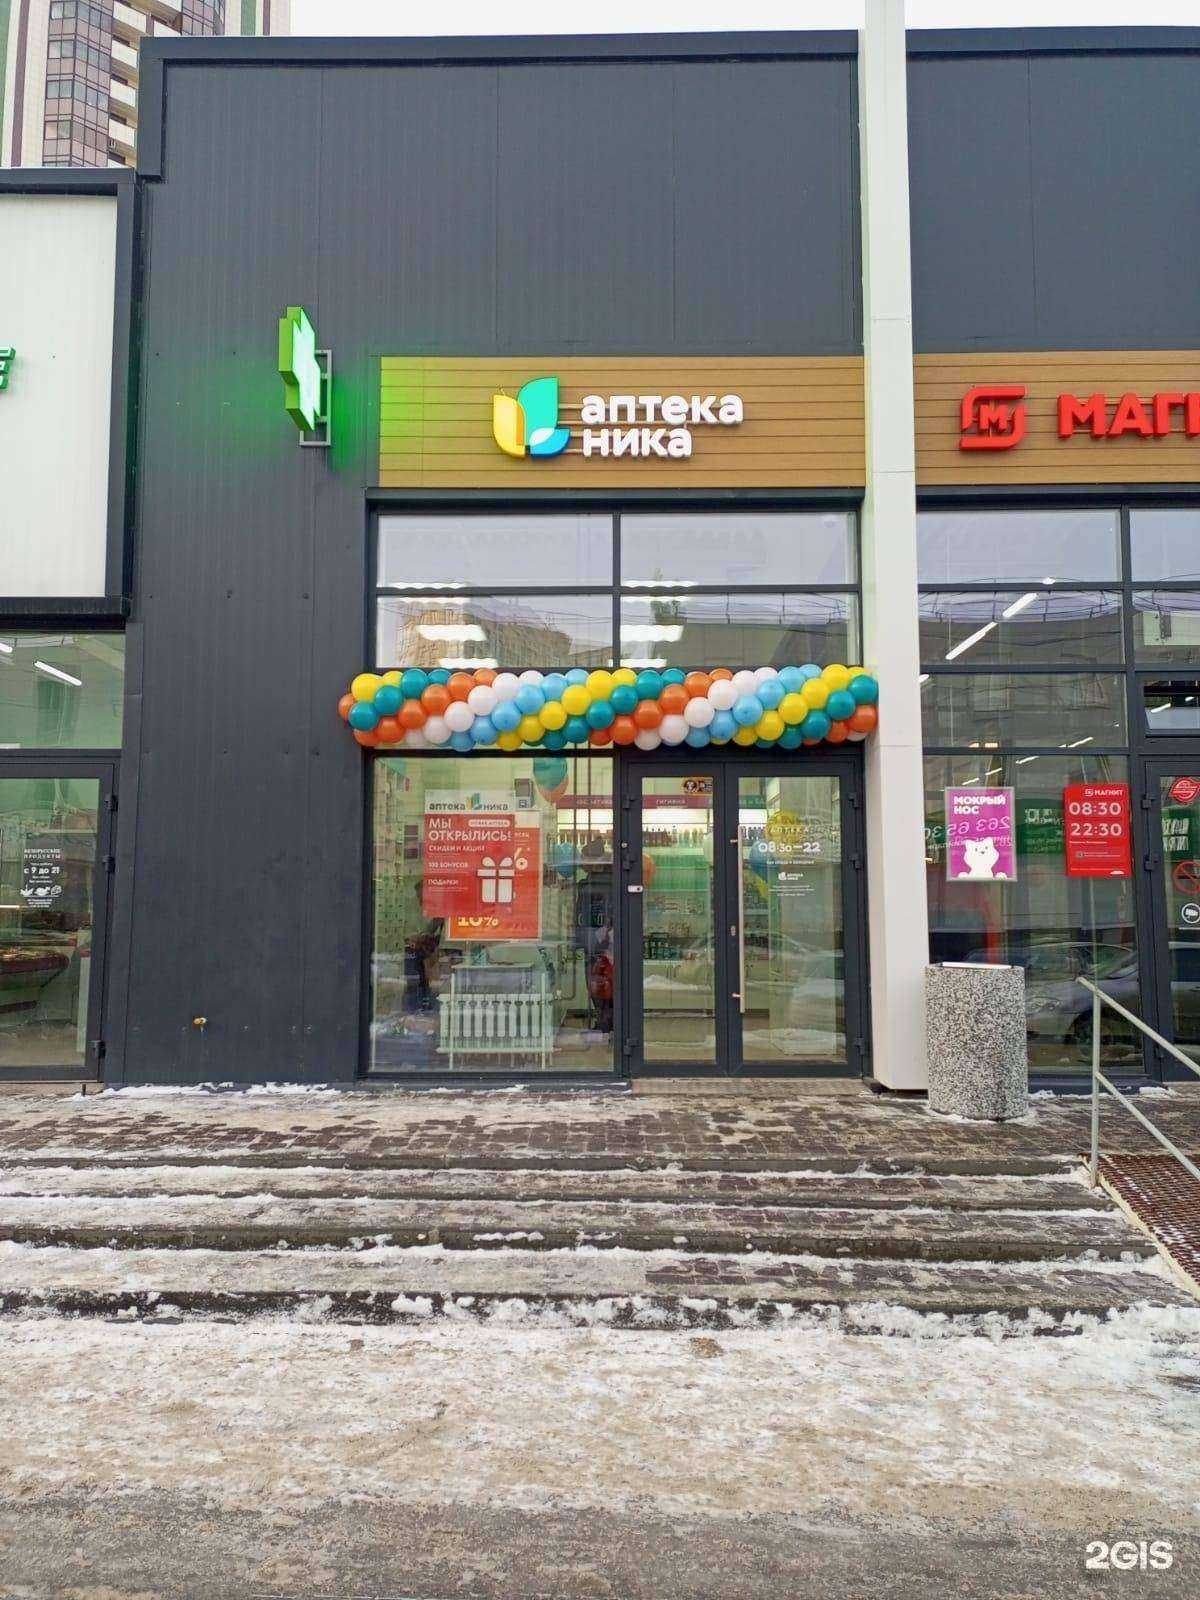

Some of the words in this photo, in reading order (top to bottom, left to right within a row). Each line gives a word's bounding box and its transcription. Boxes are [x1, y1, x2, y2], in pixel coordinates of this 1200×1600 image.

[581, 394, 744, 425] аптека
[581, 428, 693, 458] ника
[953, 794, 1006, 805] МОКРЫЙ
[428, 802, 467, 811] аптека
[483, 803, 510, 811] ника
[953, 805, 980, 815] НОС
[1069, 801, 1121, 816] 08:30
[428, 818, 452, 829] МЫ
[1070, 822, 1122, 837] 22:30
[428, 830, 512, 841] ОТКРЫЛИСЬ!
[31, 866, 37, 874] 9
